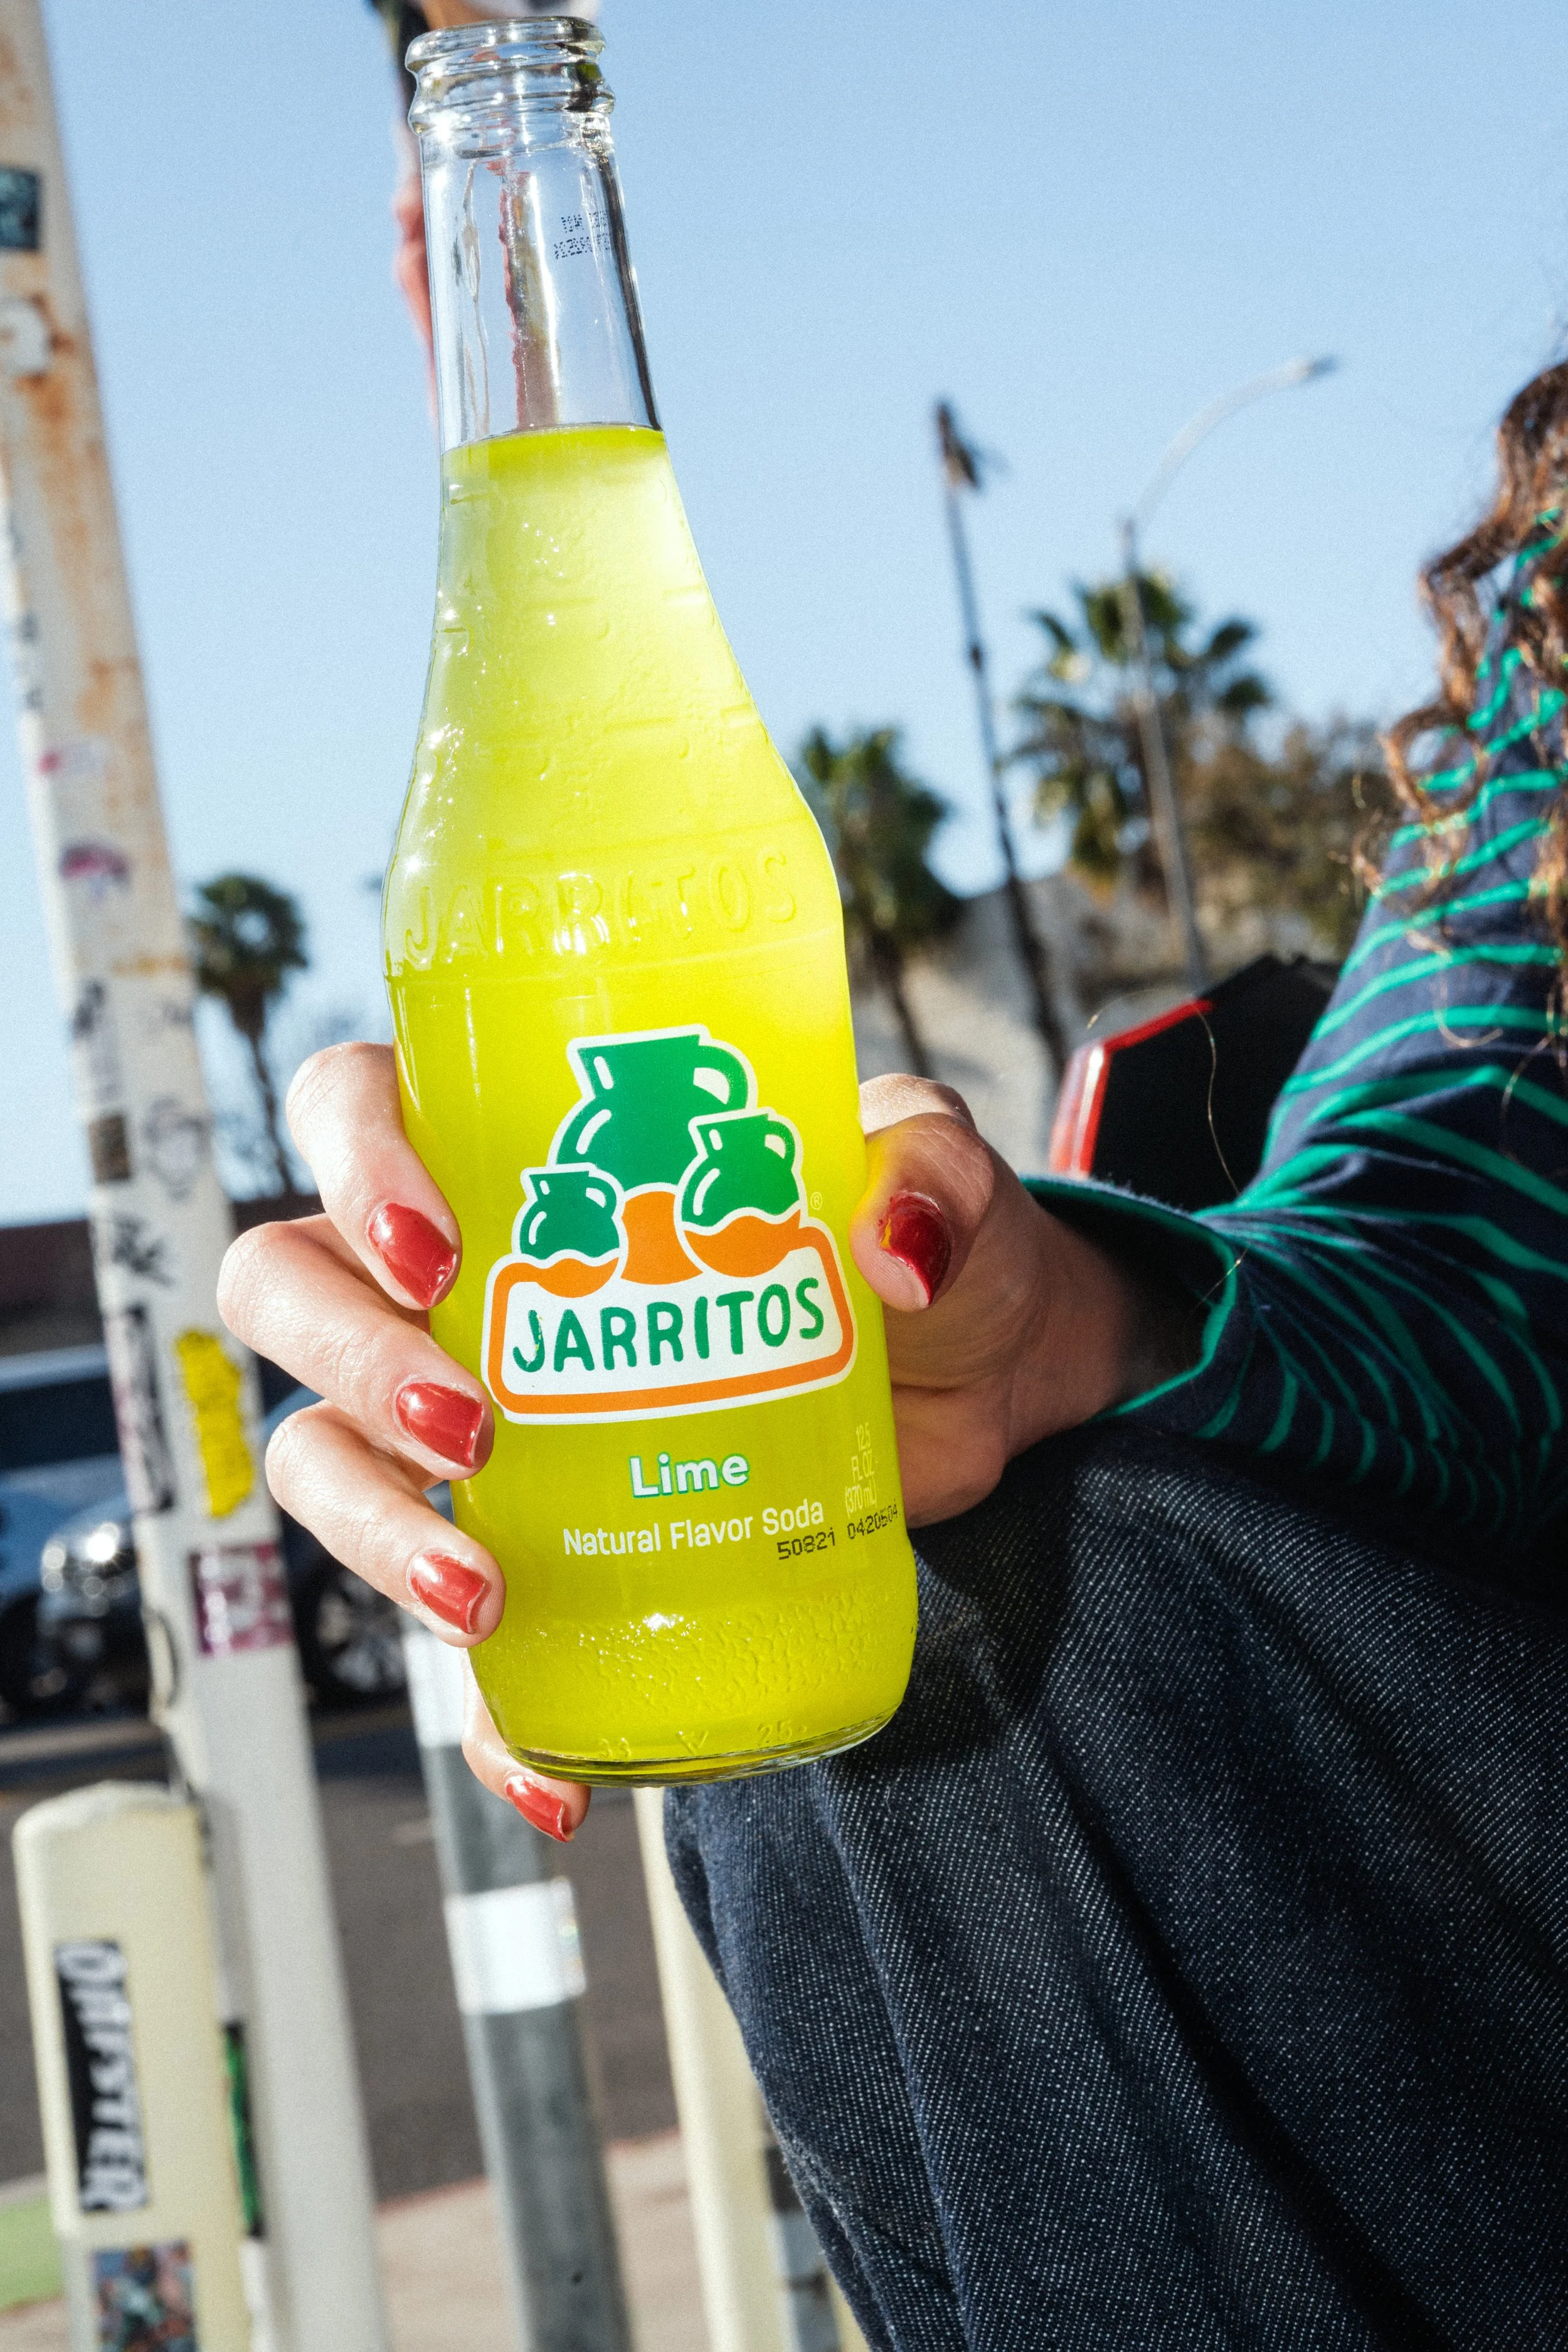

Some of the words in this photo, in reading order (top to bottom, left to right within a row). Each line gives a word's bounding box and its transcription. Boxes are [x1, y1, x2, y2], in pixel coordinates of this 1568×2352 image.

[512, 1277, 825, 1373] JARRITOS
[628, 1451, 750, 1498] Lime
[851, 1455, 863, 1483] FL
[563, 1523, 661, 1556] Natural
[670, 1515, 753, 1550] Flavor
[761, 1498, 824, 1535] Soda
[776, 1527, 835, 1560] 50821
